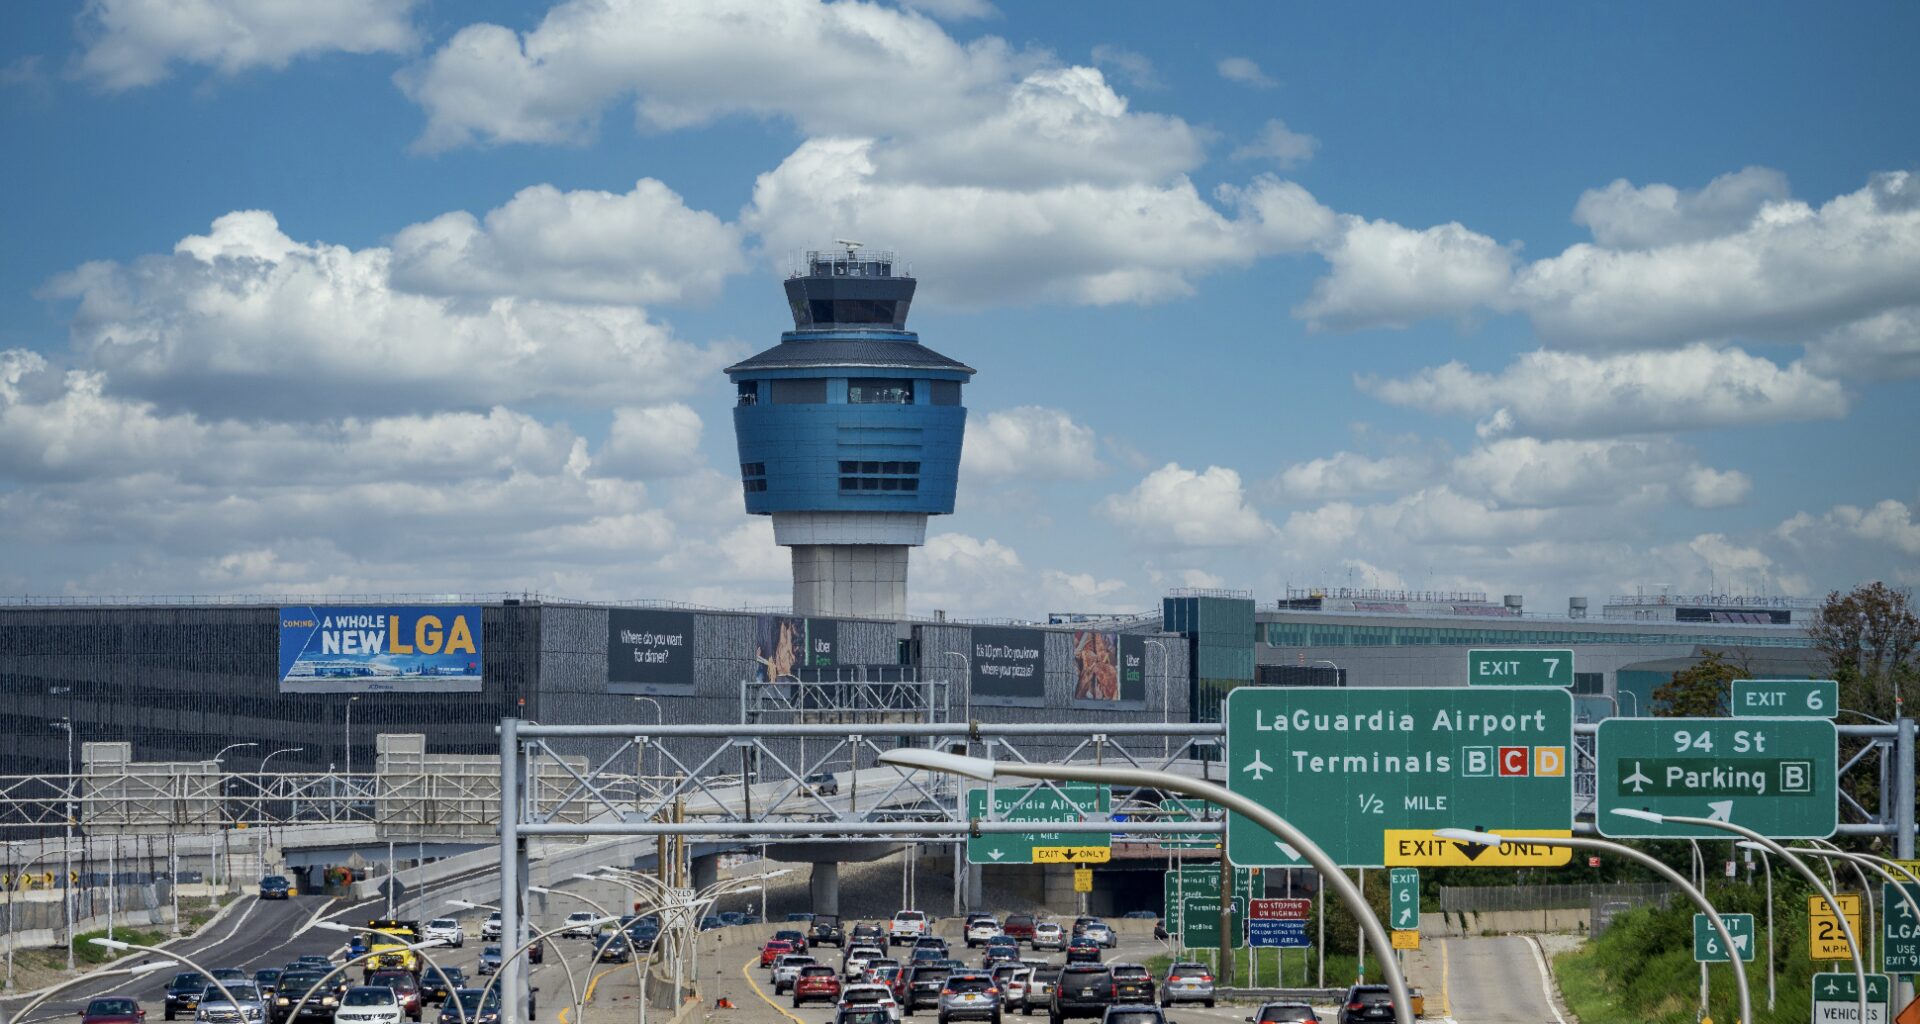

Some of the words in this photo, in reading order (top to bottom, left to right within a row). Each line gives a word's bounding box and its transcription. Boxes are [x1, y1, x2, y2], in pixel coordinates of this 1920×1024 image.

[322, 616, 333, 628] A
[336, 615, 385, 628] WHOLE
[389, 614, 476, 654] LGA
[620, 629, 642, 644] Where
[643, 631, 653, 645] do
[653, 634, 666, 649] you
[666, 633, 683, 646] want
[322, 630, 385, 655] NEW
[634, 648, 644, 663] for
[644, 649, 669, 664] dinner?
[1126, 654, 1140, 667] Uber
[980, 662, 999, 675] where
[1479, 661, 1520, 675] EXIT
[1542, 658, 1560, 678] 7
[1746, 692, 1786, 706] EXIT
[1806, 689, 1823, 710] 6
[1256, 709, 1414, 731] LaGuardia
[1431, 709, 1546, 736] Airport
[1673, 730, 1713, 753] 94
[1733, 730, 1766, 753] St
[1292, 750, 1450, 773] Terminals
[1468, 750, 1486, 773] B
[1504, 750, 1522, 773] C
[1540, 751, 1559, 772] D
[1666, 766, 1766, 795] Parking
[1785, 766, 1804, 788] B
[979, 799, 1045, 810] LGurdia
[1404, 796, 1447, 810] MILE
[1041, 832, 1059, 840] MILE
[1038, 850, 1059, 858] EXIT
[1079, 850, 1105, 858] ONLY
[1399, 840, 1447, 856] EXIT
[1392, 874, 1417, 884] EXIT
[1400, 888, 1411, 902] 6
[1189, 903, 1222, 911] Termina
[1707, 918, 1740, 931] EIT
[1706, 937, 1718, 954] 6
[1823, 945, 1850, 953] M.P.H.
[1896, 945, 1915, 954] USE
[1886, 956, 1906, 965] EXIT
[1847, 981, 1878, 994] LA
